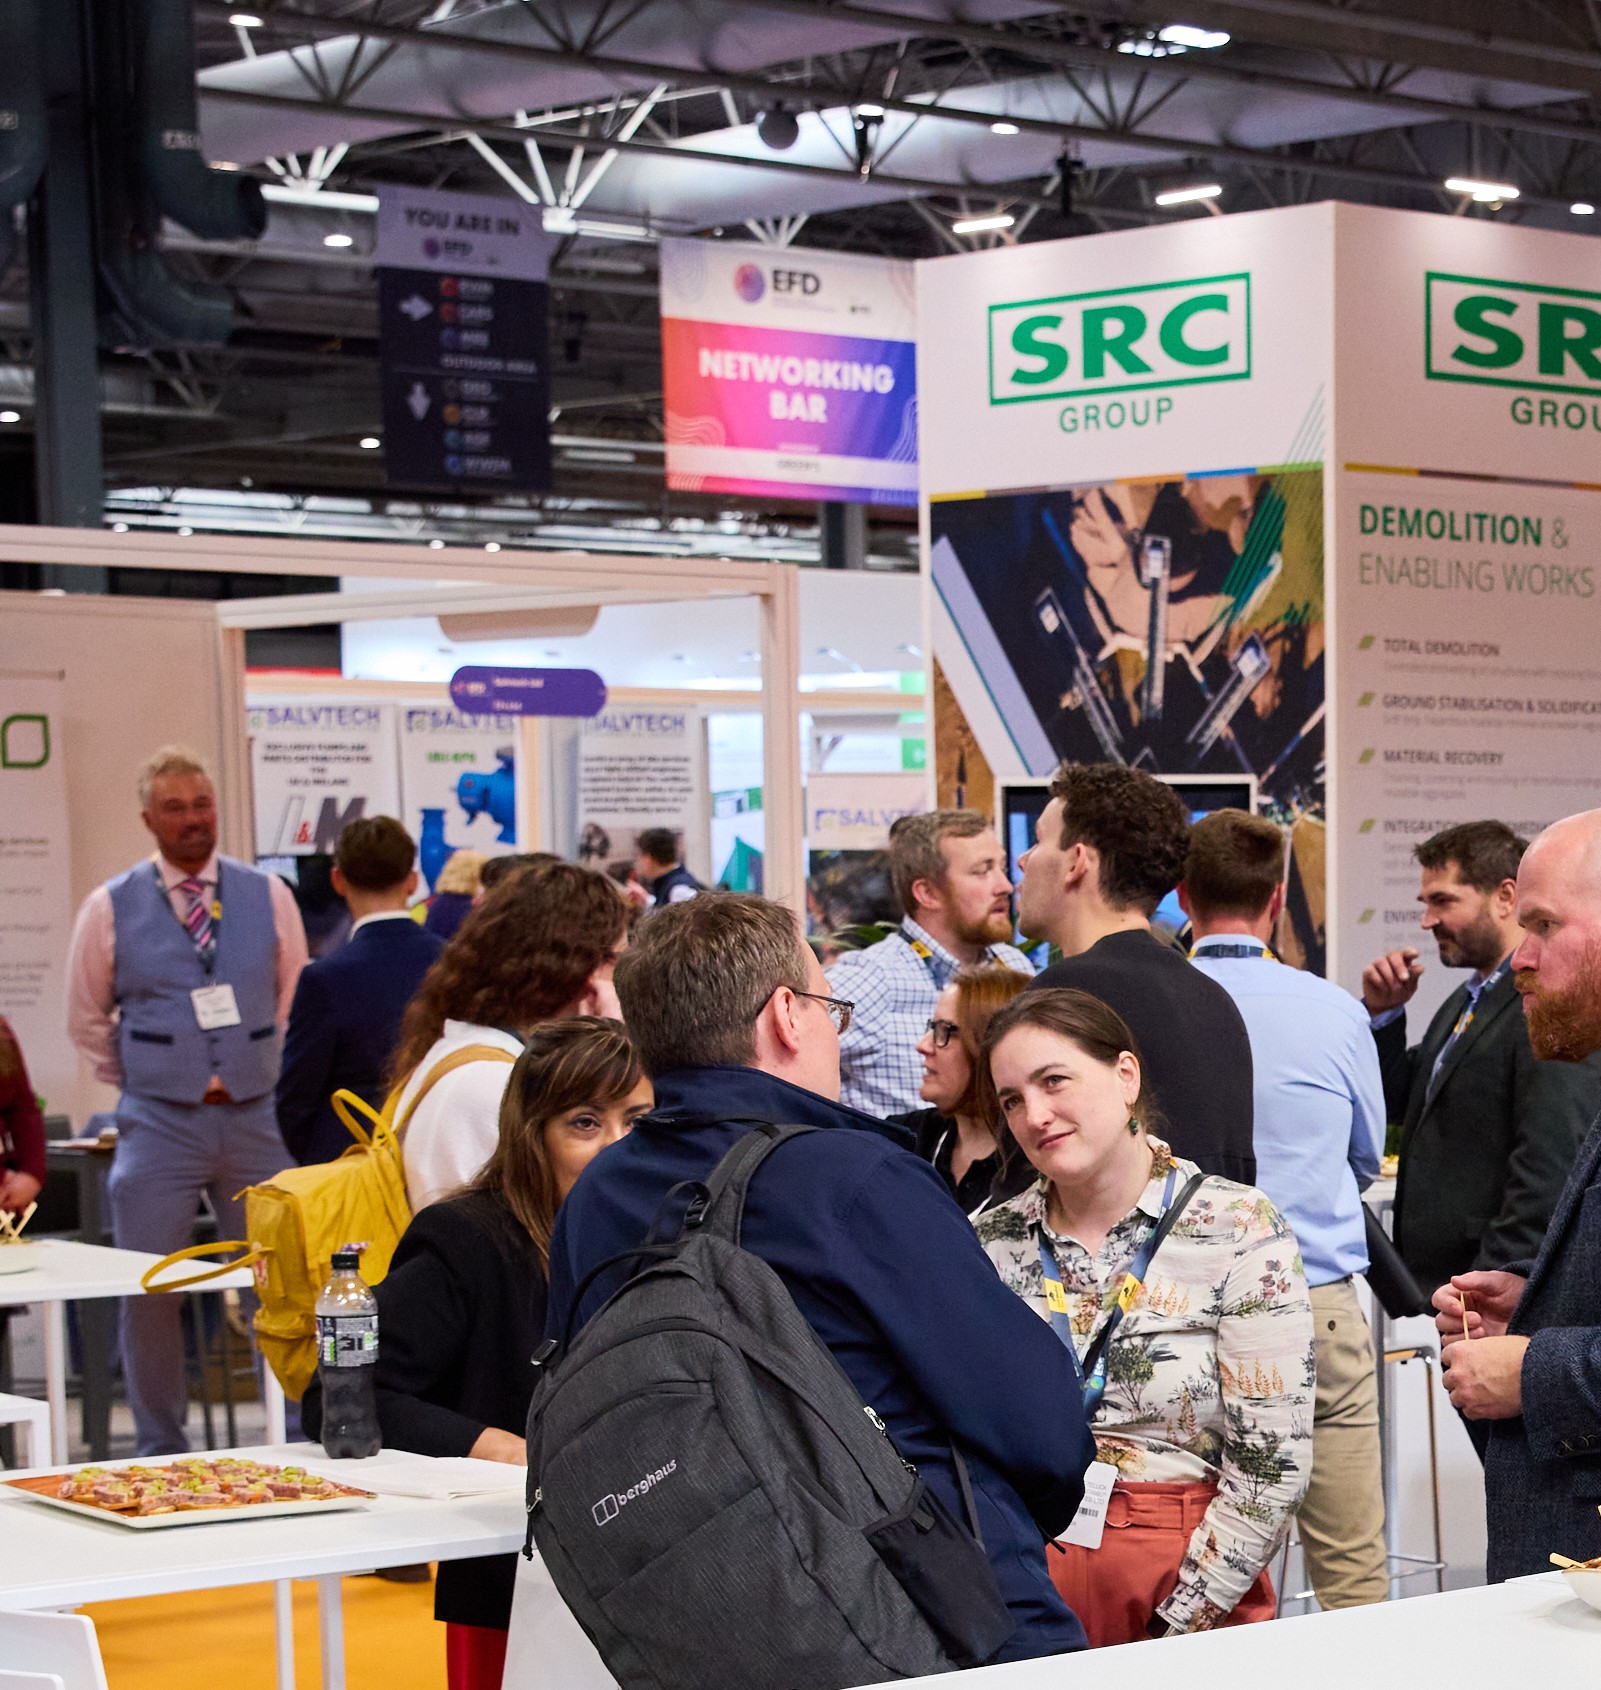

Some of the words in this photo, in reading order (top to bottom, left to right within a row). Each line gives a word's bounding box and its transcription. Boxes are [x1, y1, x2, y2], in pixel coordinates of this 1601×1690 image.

[404, 207, 449, 228] YOU
[454, 212, 491, 234] ARE
[496, 217, 520, 236] IN
[772, 270, 821, 295] EFD
[1010, 294, 1229, 385] SRC
[699, 347, 896, 394] NETWORKING
[769, 390, 828, 424] BAR
[1059, 397, 1173, 433] GROUP
[1359, 504, 1542, 546] DEMOLITION
[1551, 518, 1569, 549] &
[1359, 553, 1495, 593] ENABLING
[1502, 563, 1596, 598] WORKS
[1383, 638, 1421, 654] TOTAL
[1424, 640, 1500, 656] DEMOLITION
[1382, 693, 1435, 710] GROUND
[1438, 695, 1523, 712] STABILISATION
[1383, 750, 1441, 764] MATERIAL
[1445, 752, 1503, 765] RECOVERY
[617, 1459, 677, 1506] berghaus
